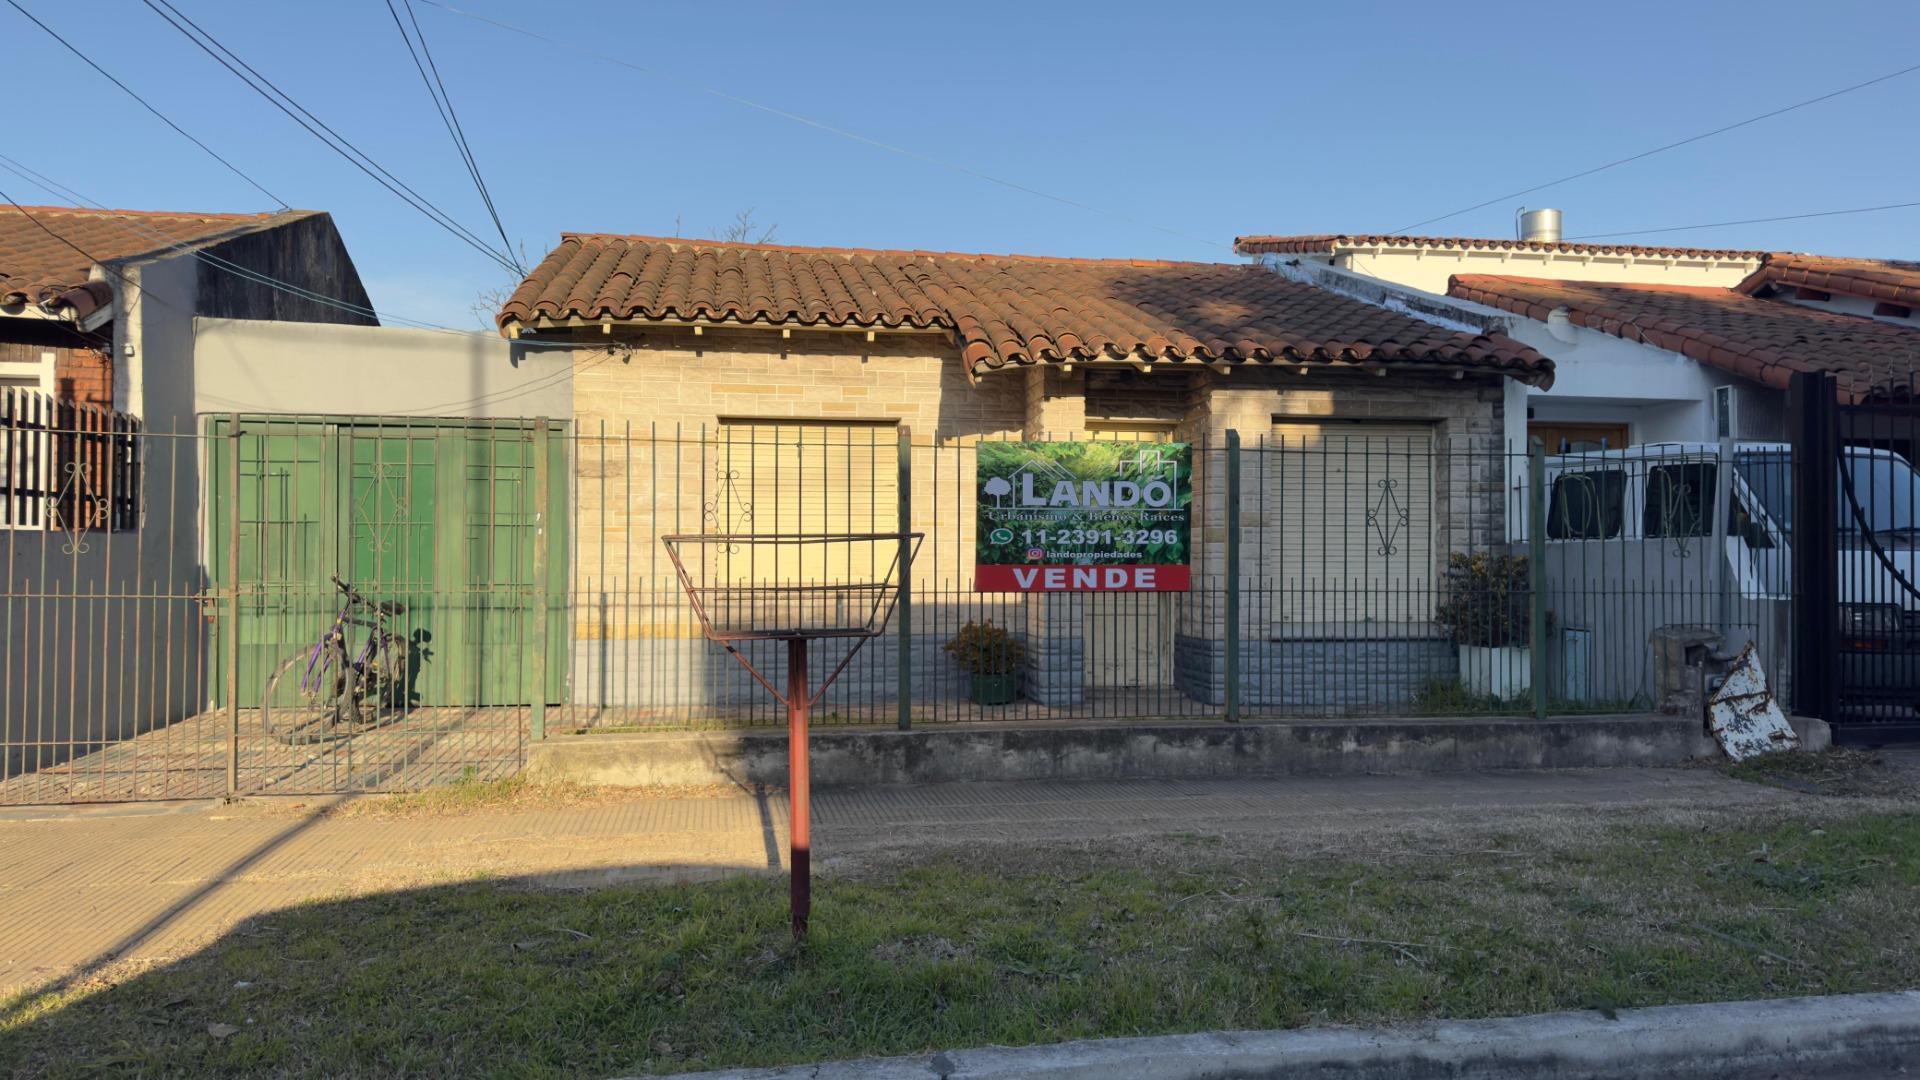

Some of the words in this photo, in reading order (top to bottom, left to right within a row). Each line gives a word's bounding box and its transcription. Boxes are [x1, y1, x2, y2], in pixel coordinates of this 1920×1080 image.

[1072, 511, 1083, 521] &
[1089, 511, 1135, 521] Bienes
[1021, 529, 1178, 545] 11-2391-3296
[1046, 550, 1143, 560] landopropiedades
[1012, 567, 1156, 588] VENDE
